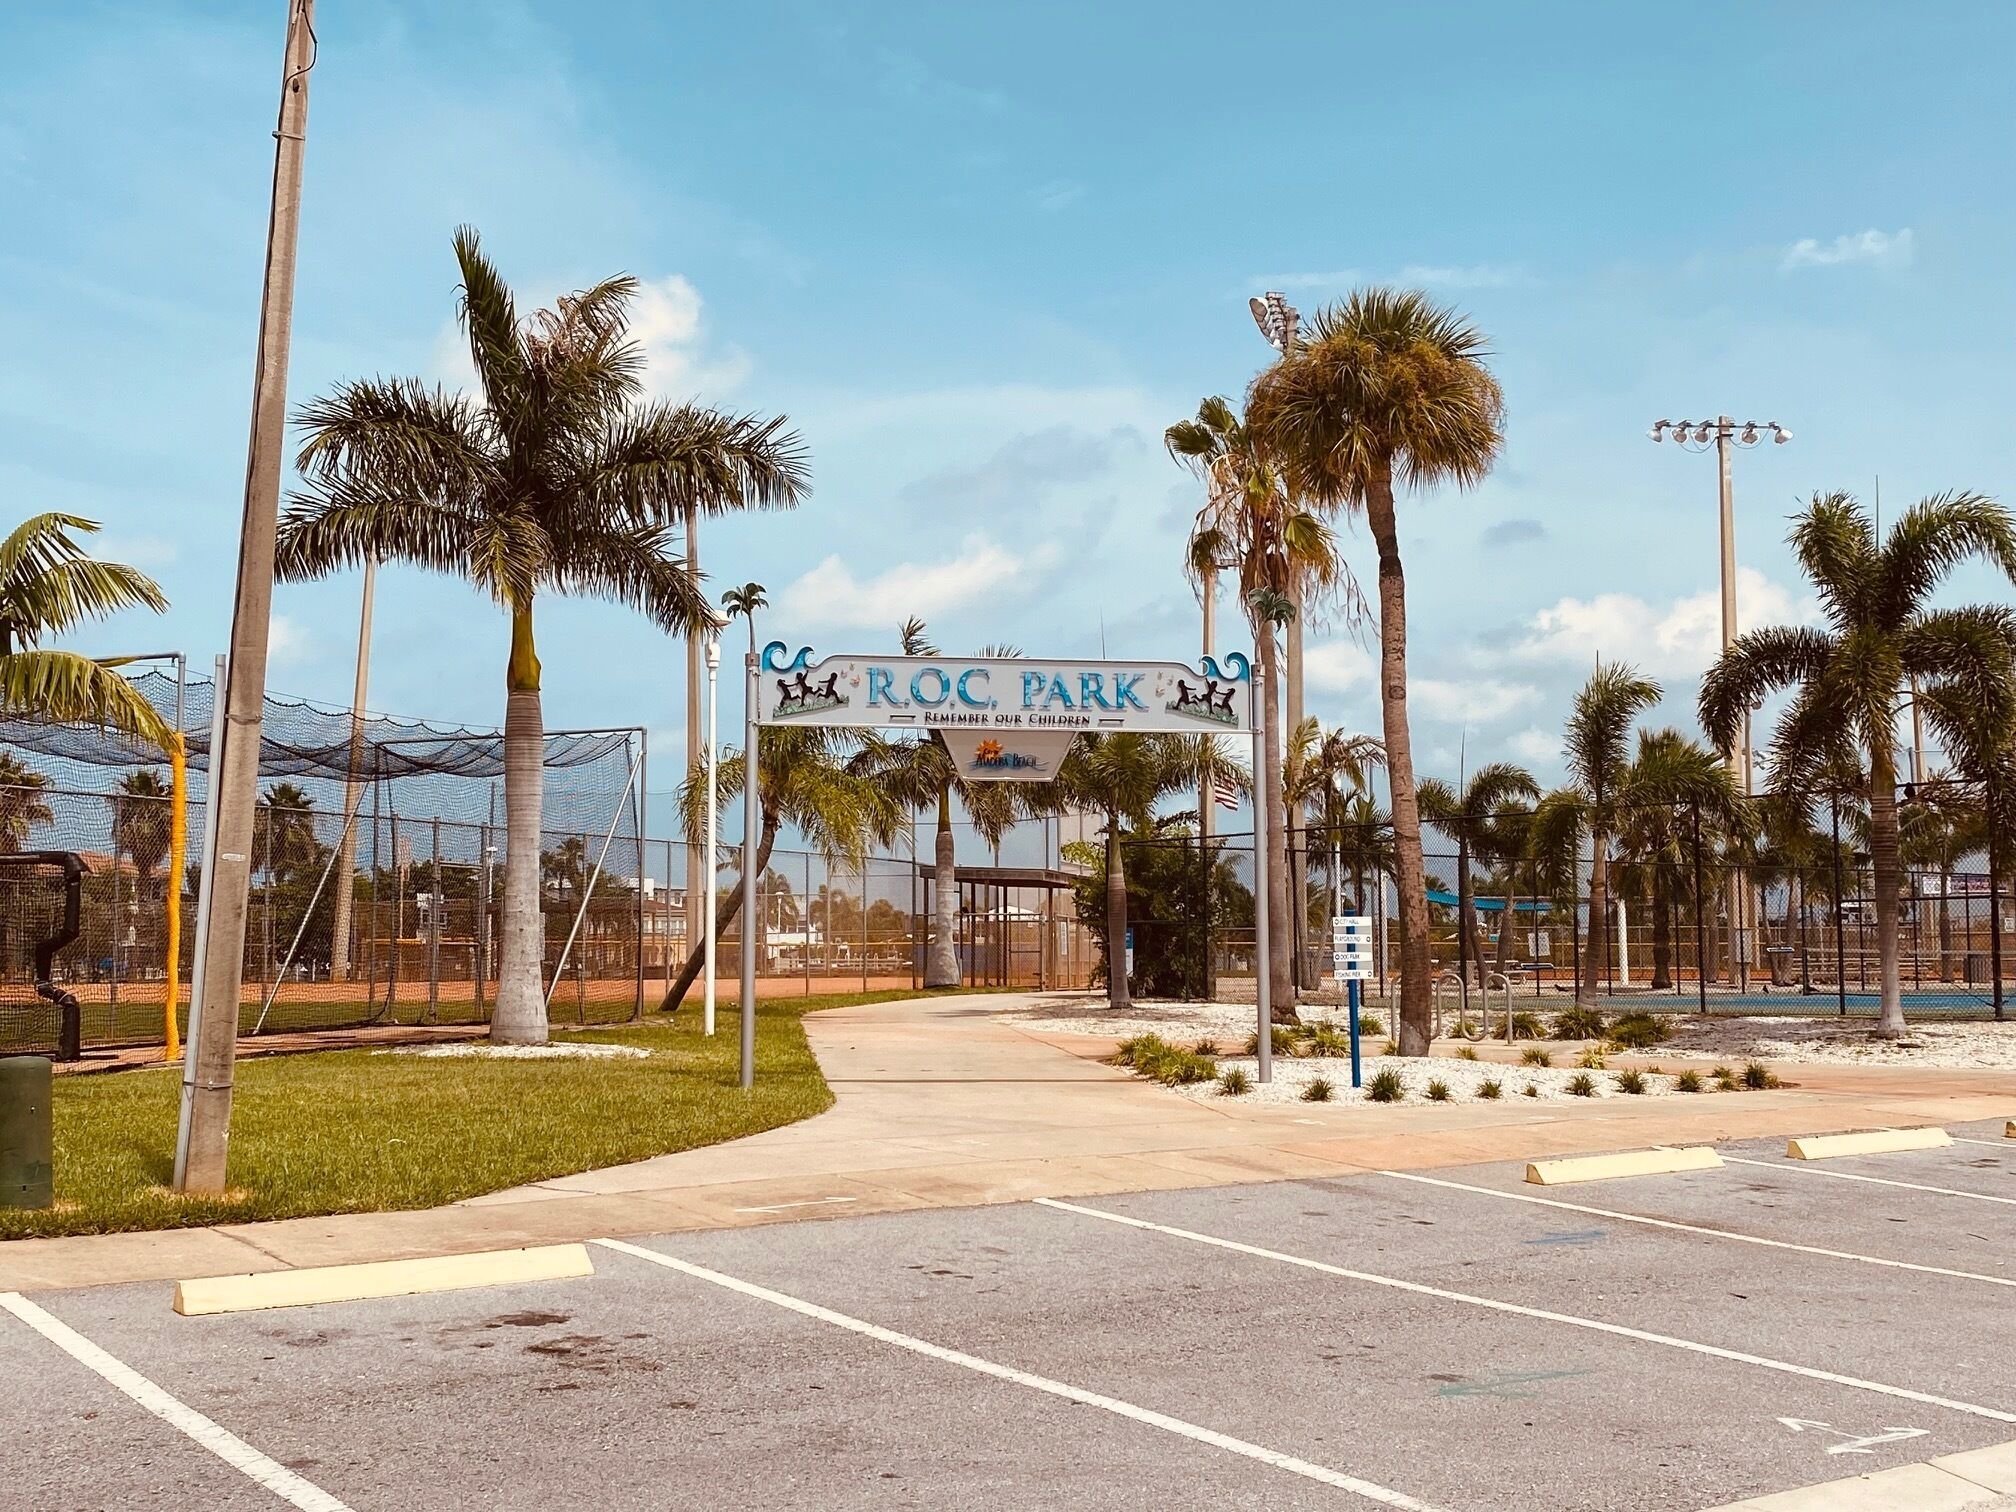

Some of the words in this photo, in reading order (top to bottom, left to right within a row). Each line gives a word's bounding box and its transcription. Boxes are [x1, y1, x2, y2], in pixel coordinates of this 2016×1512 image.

[866, 667, 997, 709] R.O.C.
[1019, 671, 1149, 711] PARK
[925, 711, 989, 723] REMEMBER
[995, 713, 1023, 724] OUR
[1029, 713, 1090, 724] CHILDREN
